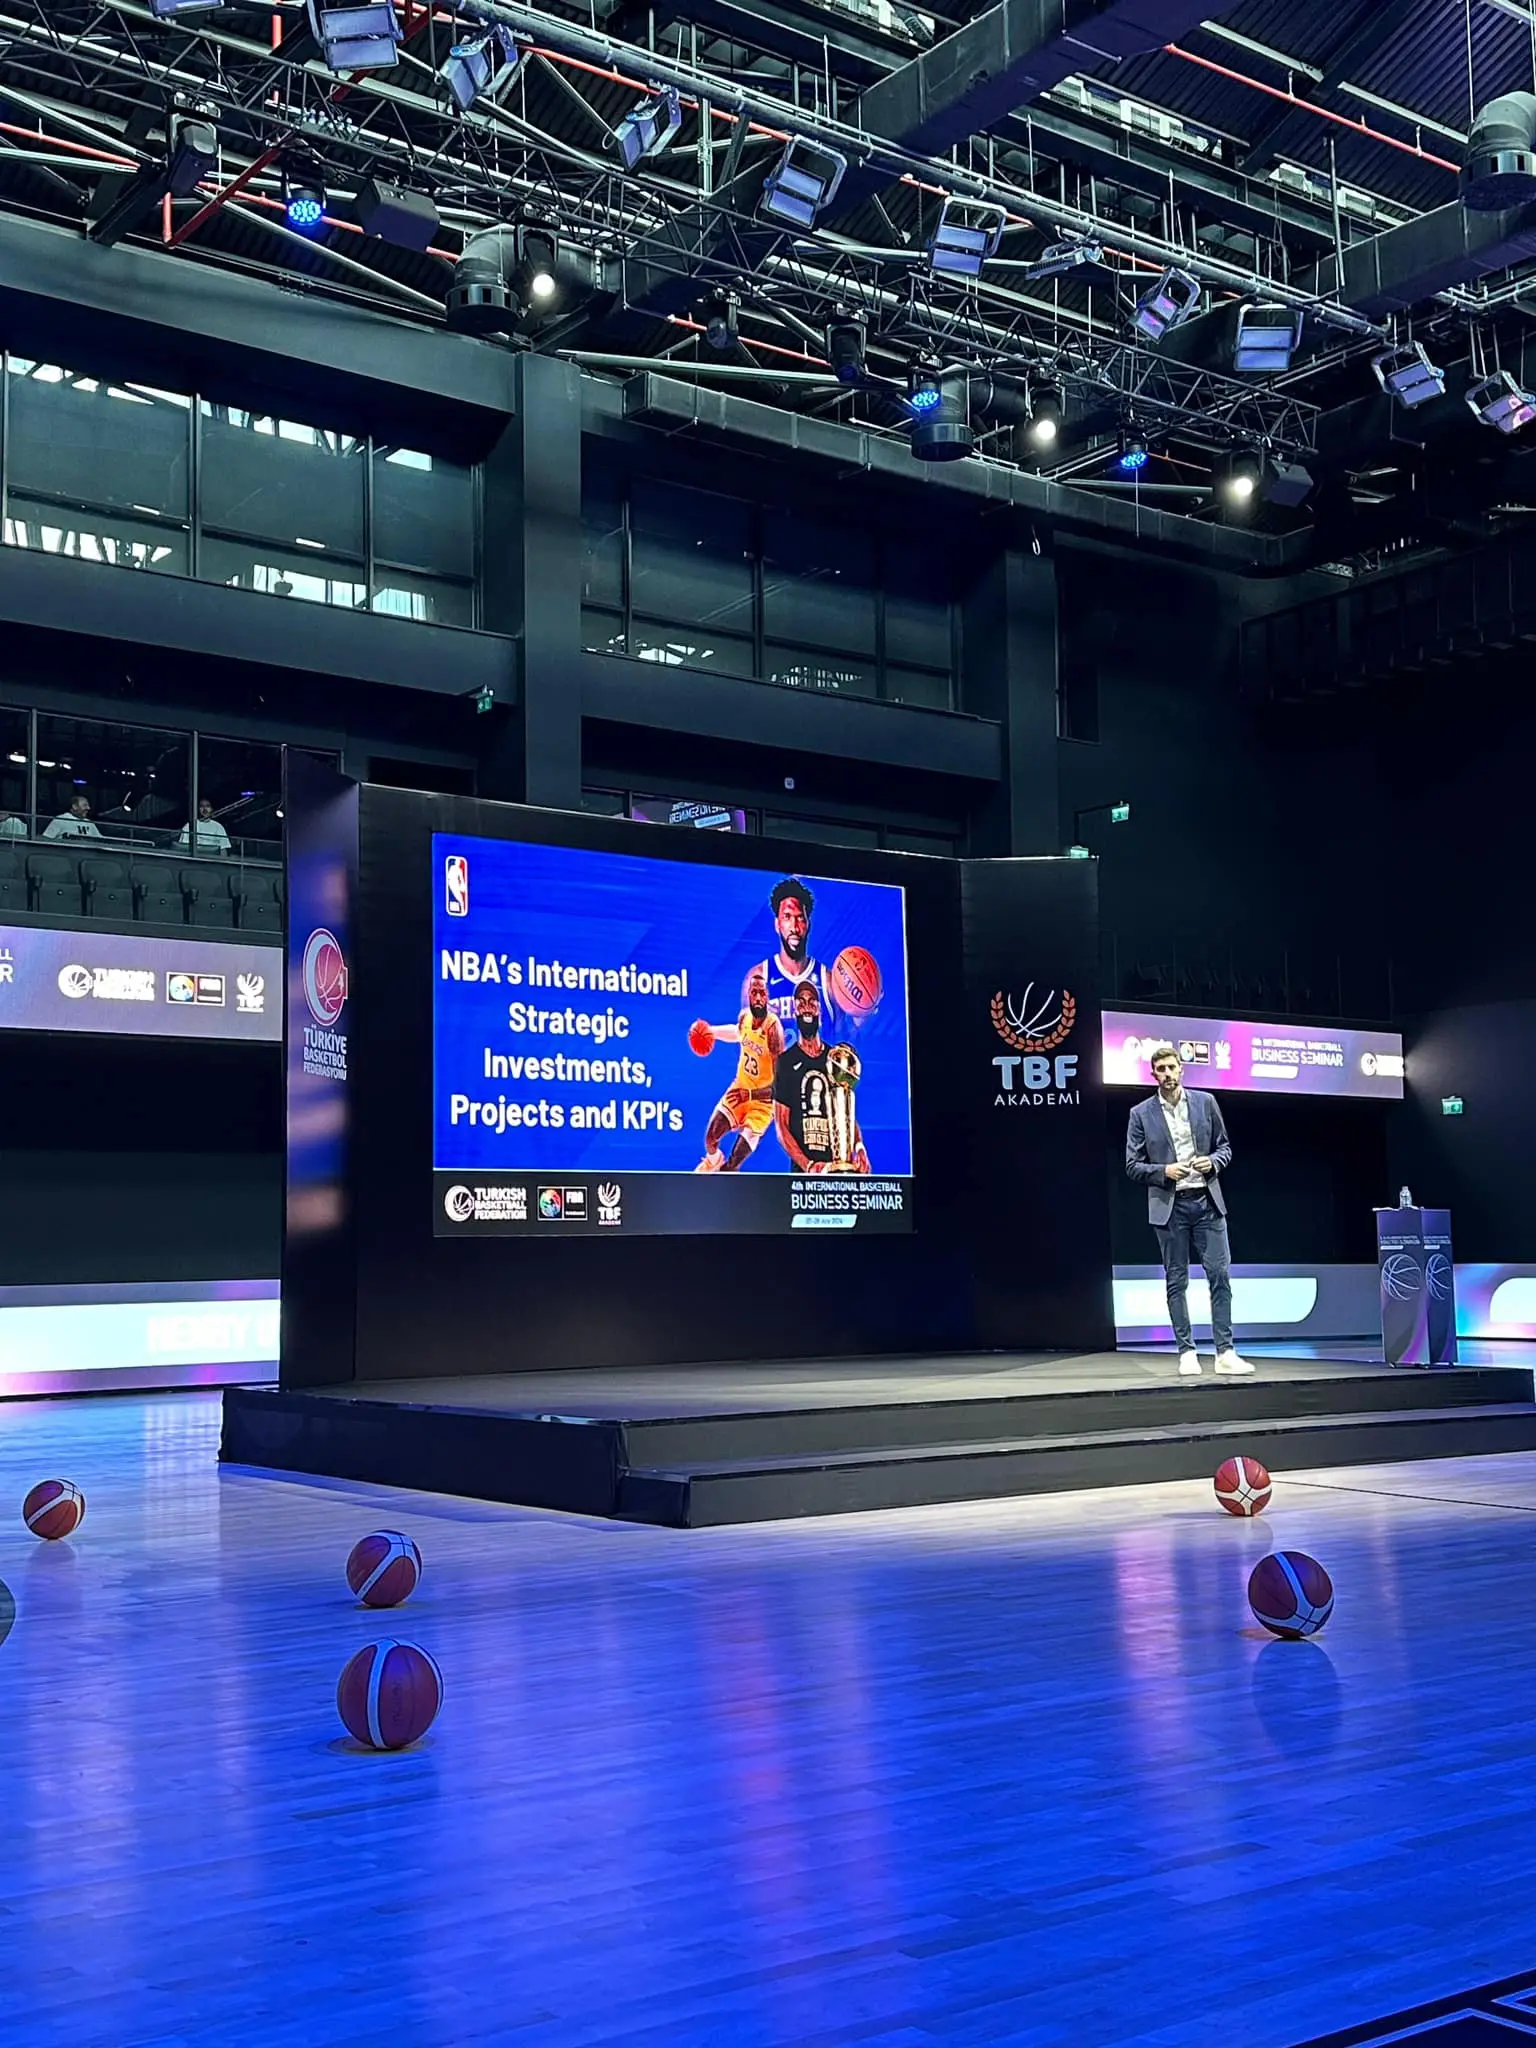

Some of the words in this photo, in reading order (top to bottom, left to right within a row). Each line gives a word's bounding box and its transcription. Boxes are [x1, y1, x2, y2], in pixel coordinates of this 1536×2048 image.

[441, 949, 522, 984] NBA's
[528, 956, 688, 997] International
[509, 1002, 630, 1044] Strategic
[303, 1023, 347, 1055] TÜRKİYE
[303, 1046, 347, 1069] BASKETBOL
[484, 1047, 653, 1088] Investments,
[744, 1051, 759, 1076] 23
[1251, 1047, 1299, 1064] BUSINESS
[1301, 1052, 1343, 1068] SEMINAR
[992, 1055, 1079, 1090] TBF
[450, 1094, 565, 1134] Projects
[570, 1100, 616, 1129] and
[622, 1100, 684, 1131] KPI's
[474, 1187, 527, 1201] TURKISH
[805, 1181, 859, 1192] INTERNATIONAL
[860, 1182, 902, 1193] BASKETBALL
[791, 1193, 849, 1210] BUSINESS
[851, 1194, 904, 1211] SEMINAR
